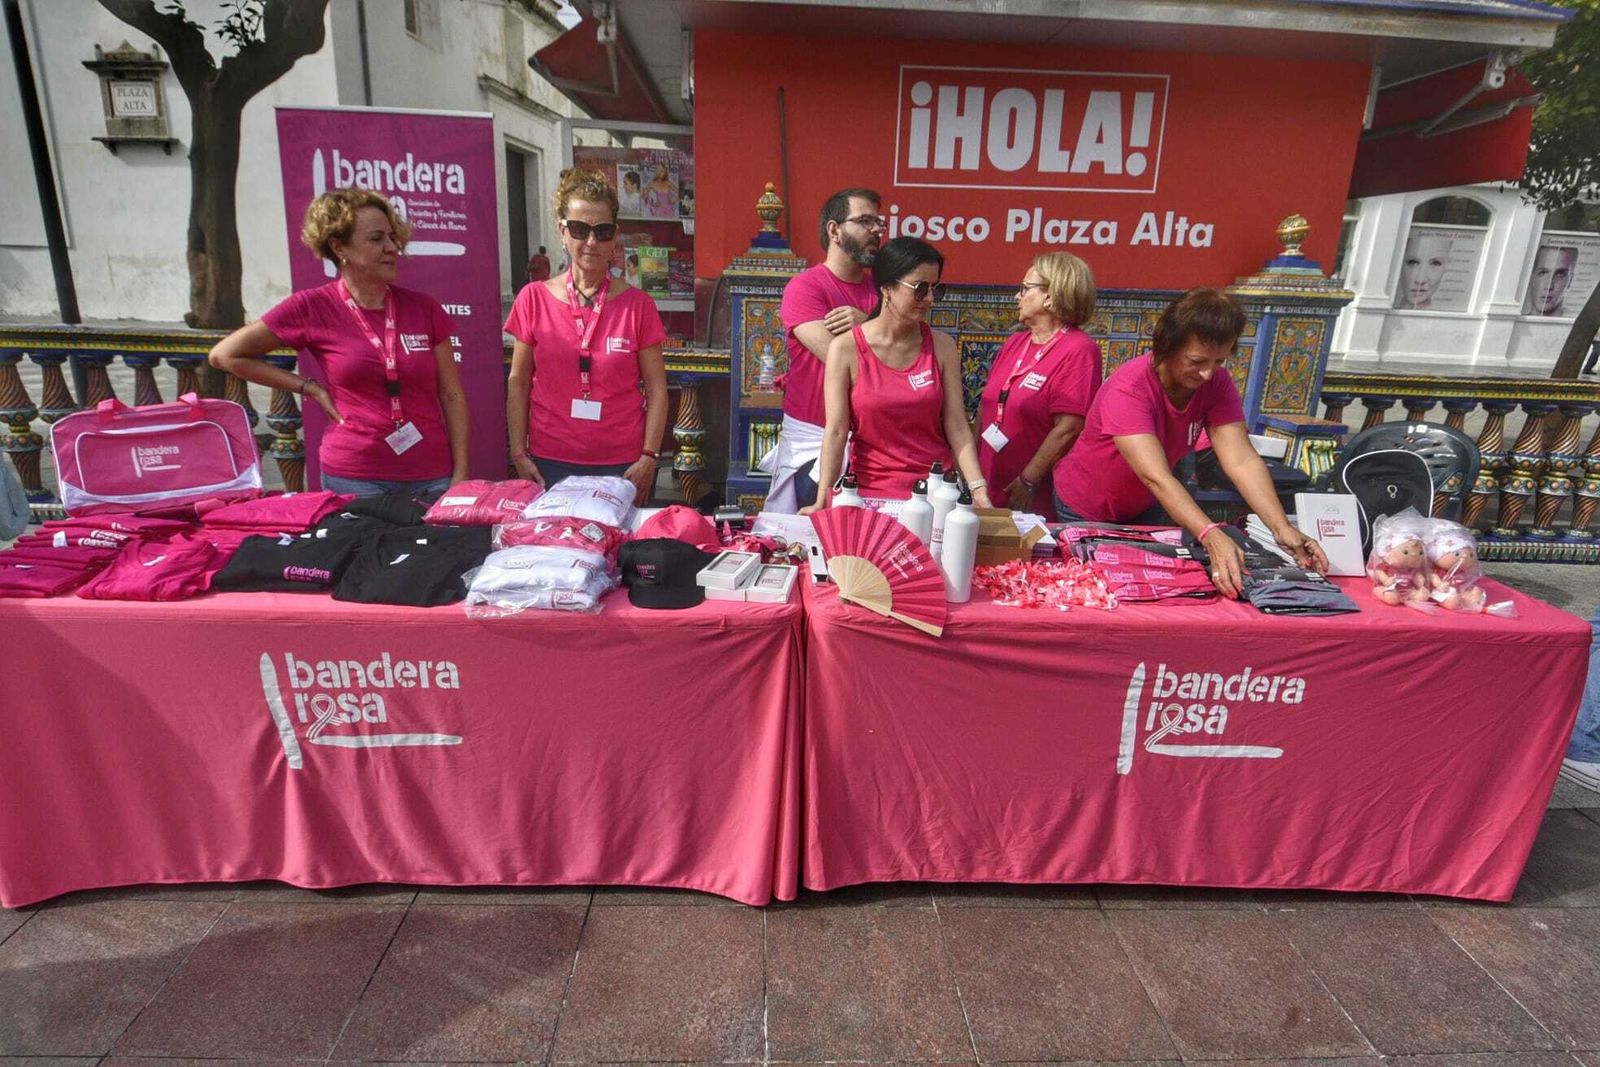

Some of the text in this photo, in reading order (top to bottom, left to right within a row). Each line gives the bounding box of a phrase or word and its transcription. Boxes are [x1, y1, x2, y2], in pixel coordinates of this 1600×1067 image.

[117, 88, 149, 97] PLAZA
[123, 101, 147, 110] ALTA
[908, 81, 1154, 176] ¡HOLA!
[332, 149, 465, 195] bandera
[879, 204, 1214, 247] iosco Plaza Alta
[646, 247, 669, 257] GEO
[137, 445, 180, 456] bandera
[139, 455, 163, 466] rosa
[285, 652, 459, 689] bandera
[1152, 663, 1306, 704] bandera
[294, 692, 388, 728] rosa
[1145, 702, 1229, 738] rosa
